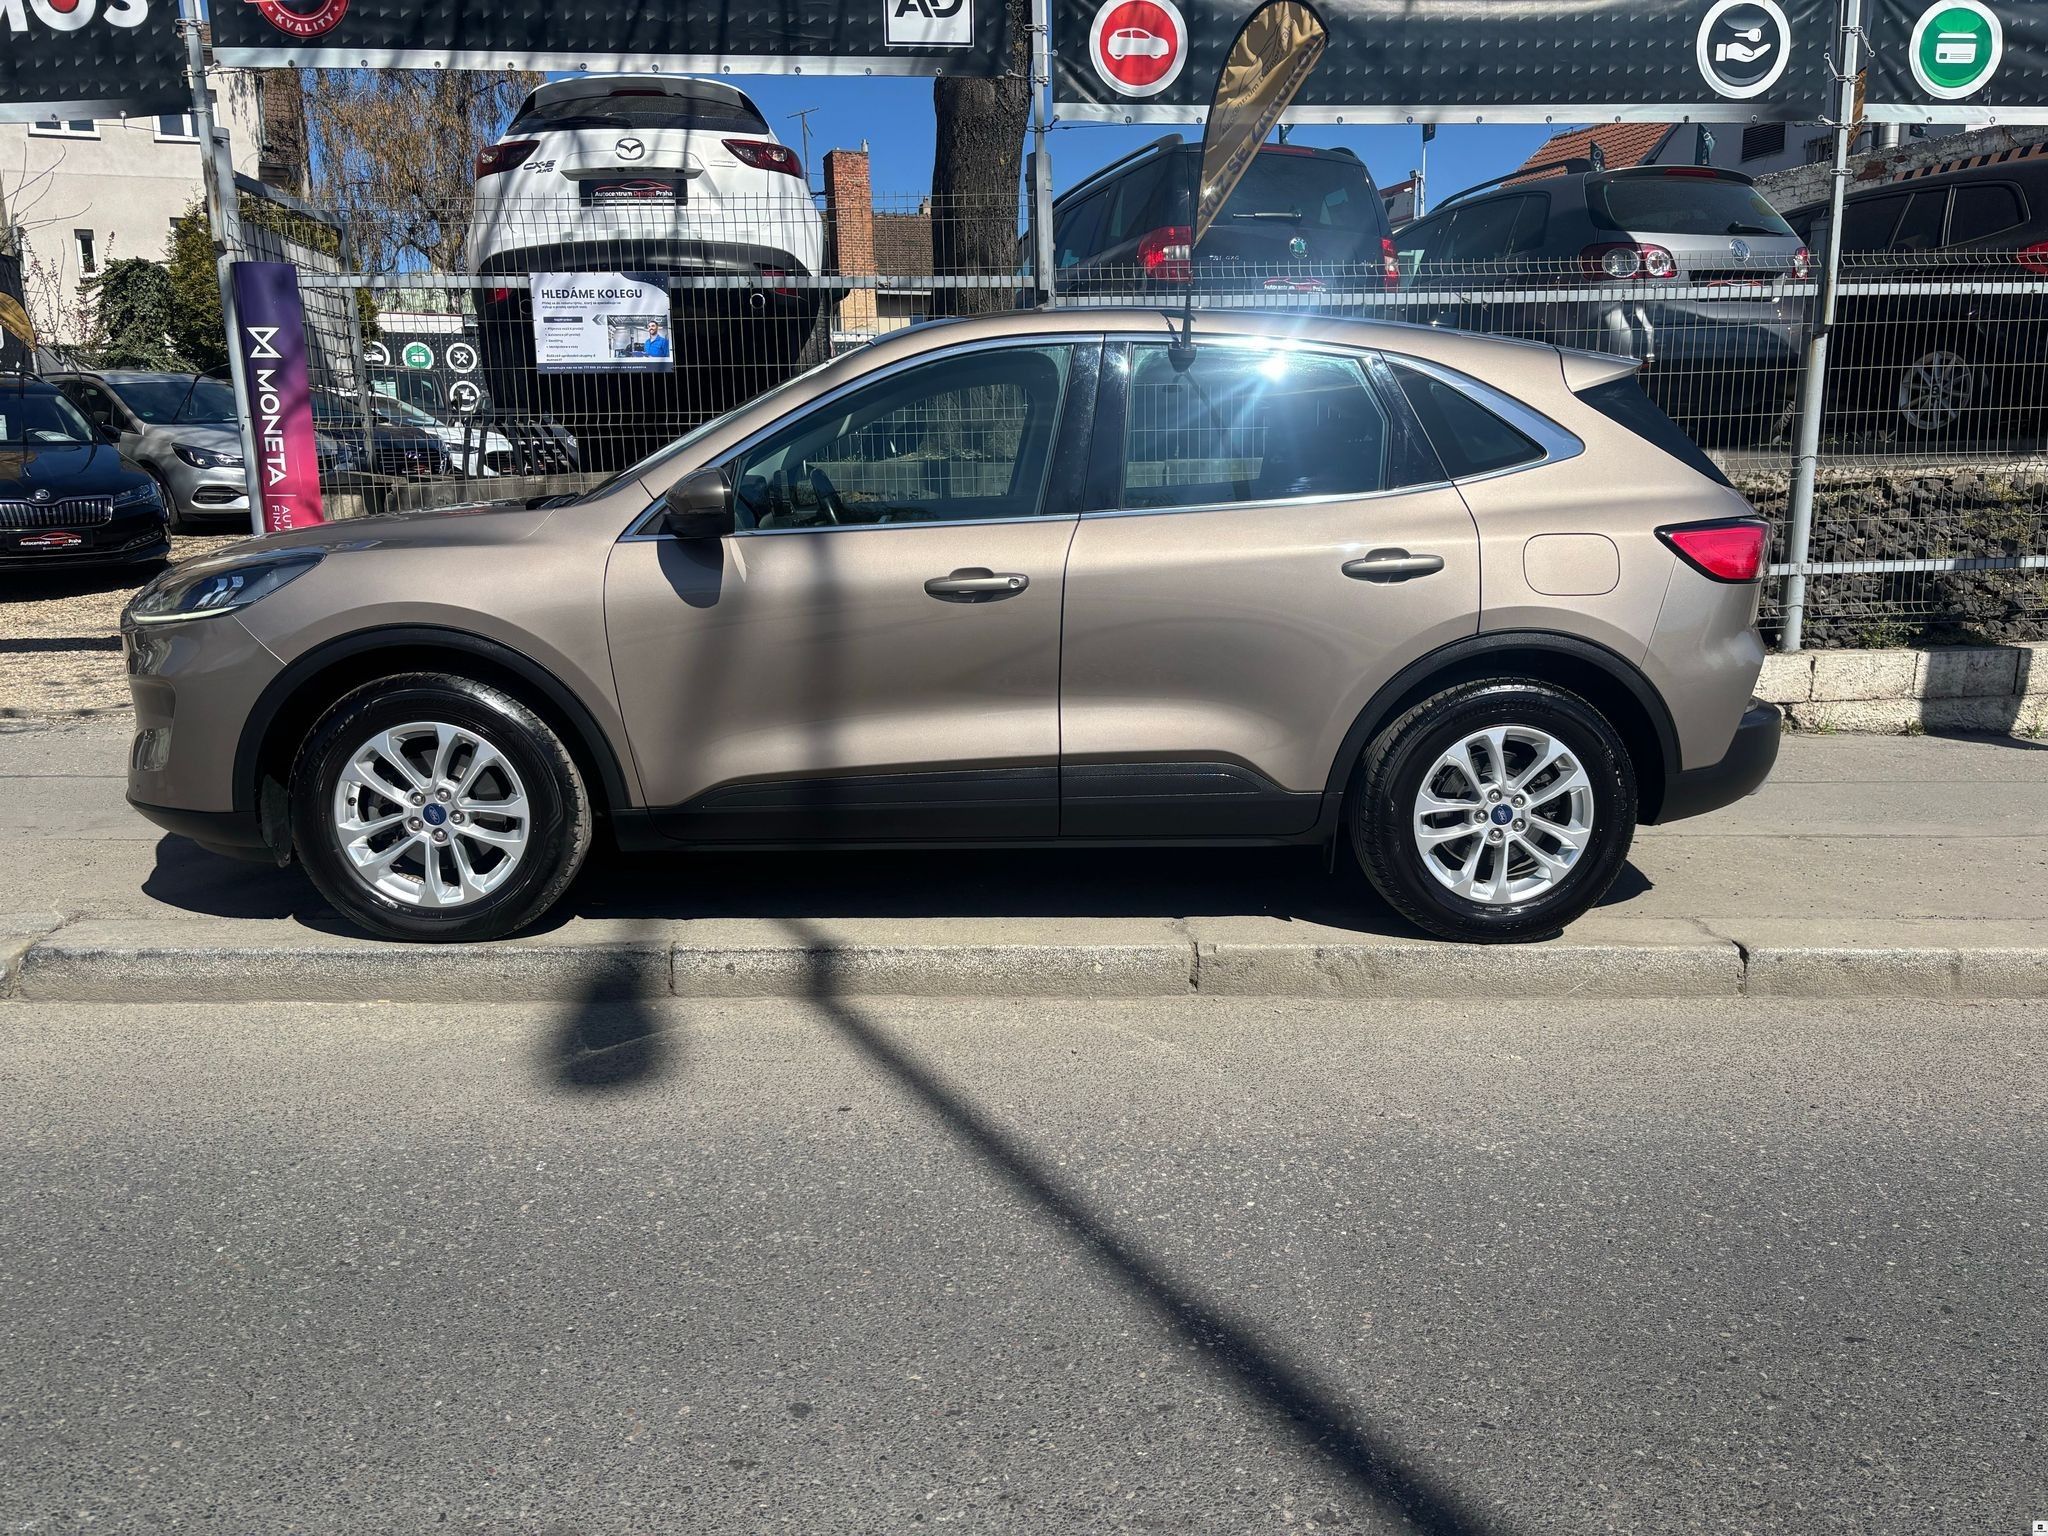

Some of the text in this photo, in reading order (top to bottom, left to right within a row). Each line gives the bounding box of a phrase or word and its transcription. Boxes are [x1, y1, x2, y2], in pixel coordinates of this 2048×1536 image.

[275, 12, 333, 32] KVALITY
[541, 287, 643, 299] HLEDÁME KOLEGU
[256, 369, 288, 487] MONETA
